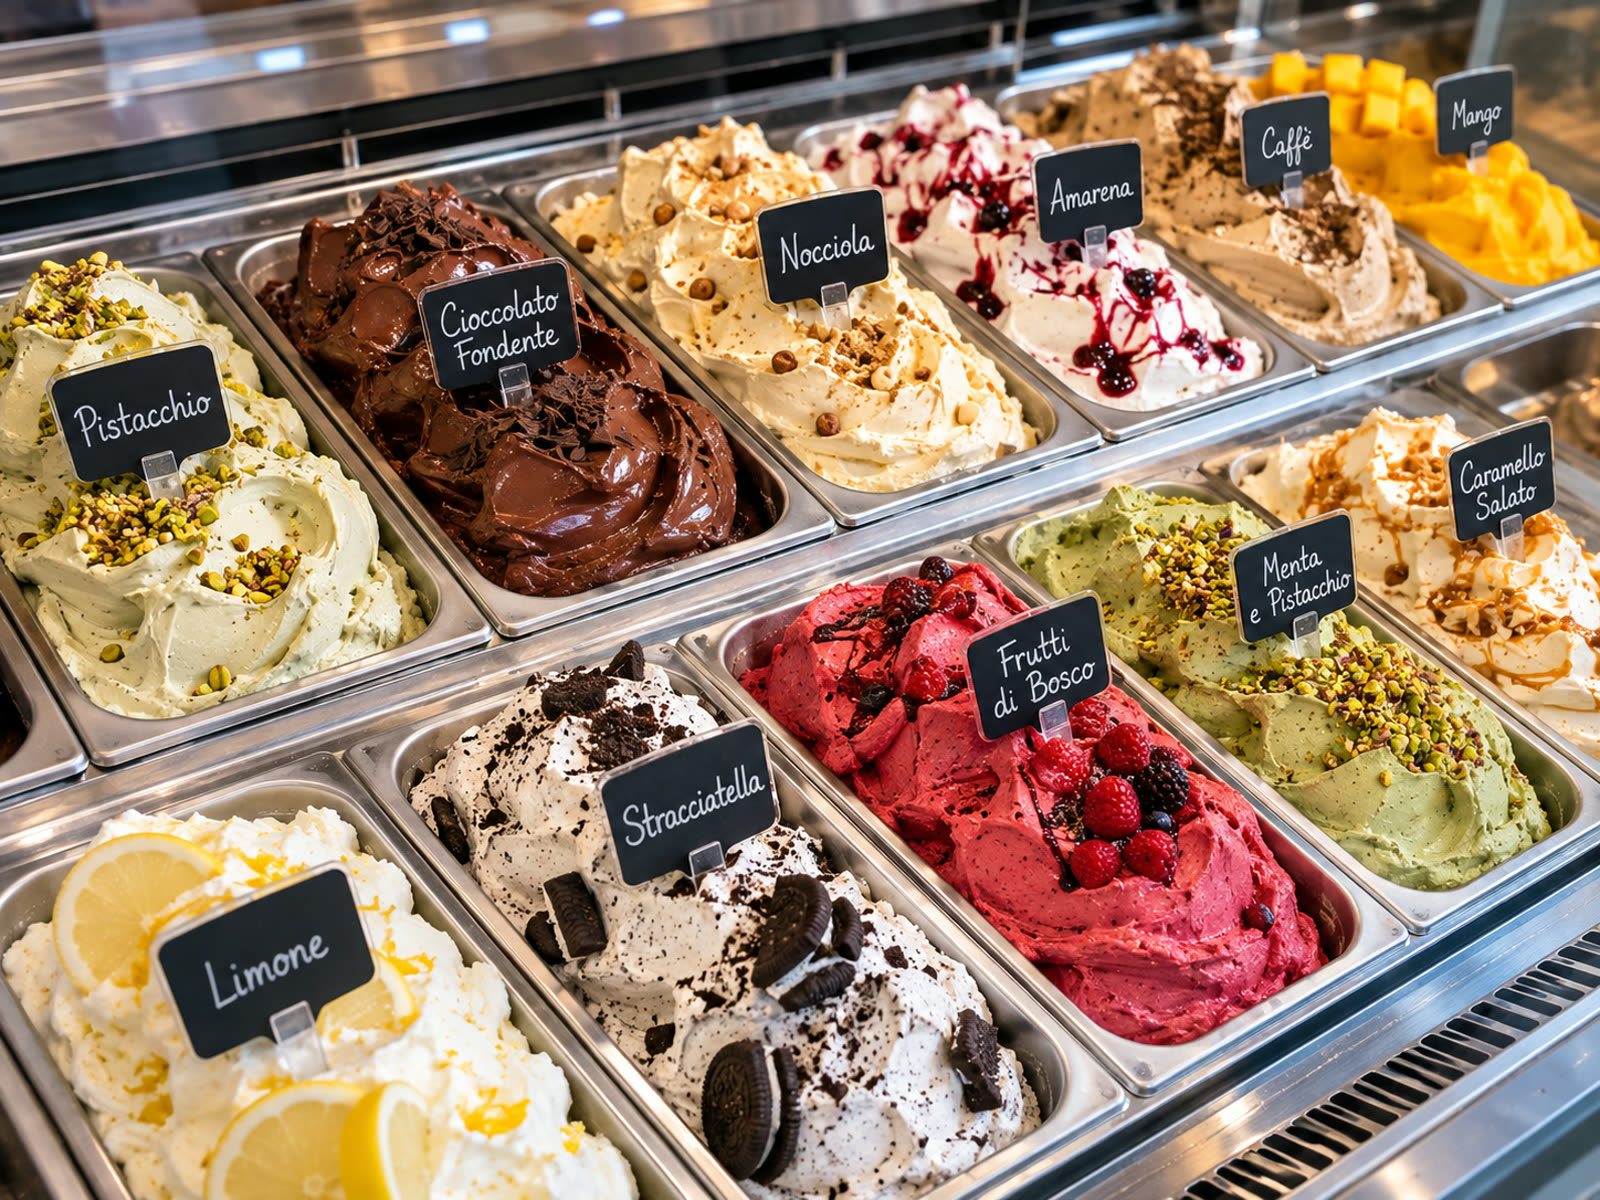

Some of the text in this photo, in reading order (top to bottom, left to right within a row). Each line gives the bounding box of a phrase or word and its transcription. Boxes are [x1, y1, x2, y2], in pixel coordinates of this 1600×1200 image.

[1451, 101, 1503, 137] Mango
[1050, 178, 1135, 216] Amarena
[780, 223, 876, 274] Nocciola
[440, 284, 559, 338] Cioccolato
[453, 324, 560, 371] Fondente
[73, 389, 212, 448] Pistacchio
[1460, 449, 1546, 495] Caramello
[1475, 483, 1538, 521] Salato
[1263, 547, 1323, 587] Menta
[1250, 570, 1352, 624] e Pistacchio
[996, 627, 1071, 676] Frutti
[994, 662, 1096, 719] di Bosco
[622, 764, 766, 847] Stracciatella
[204, 934, 329, 1009] Limone
